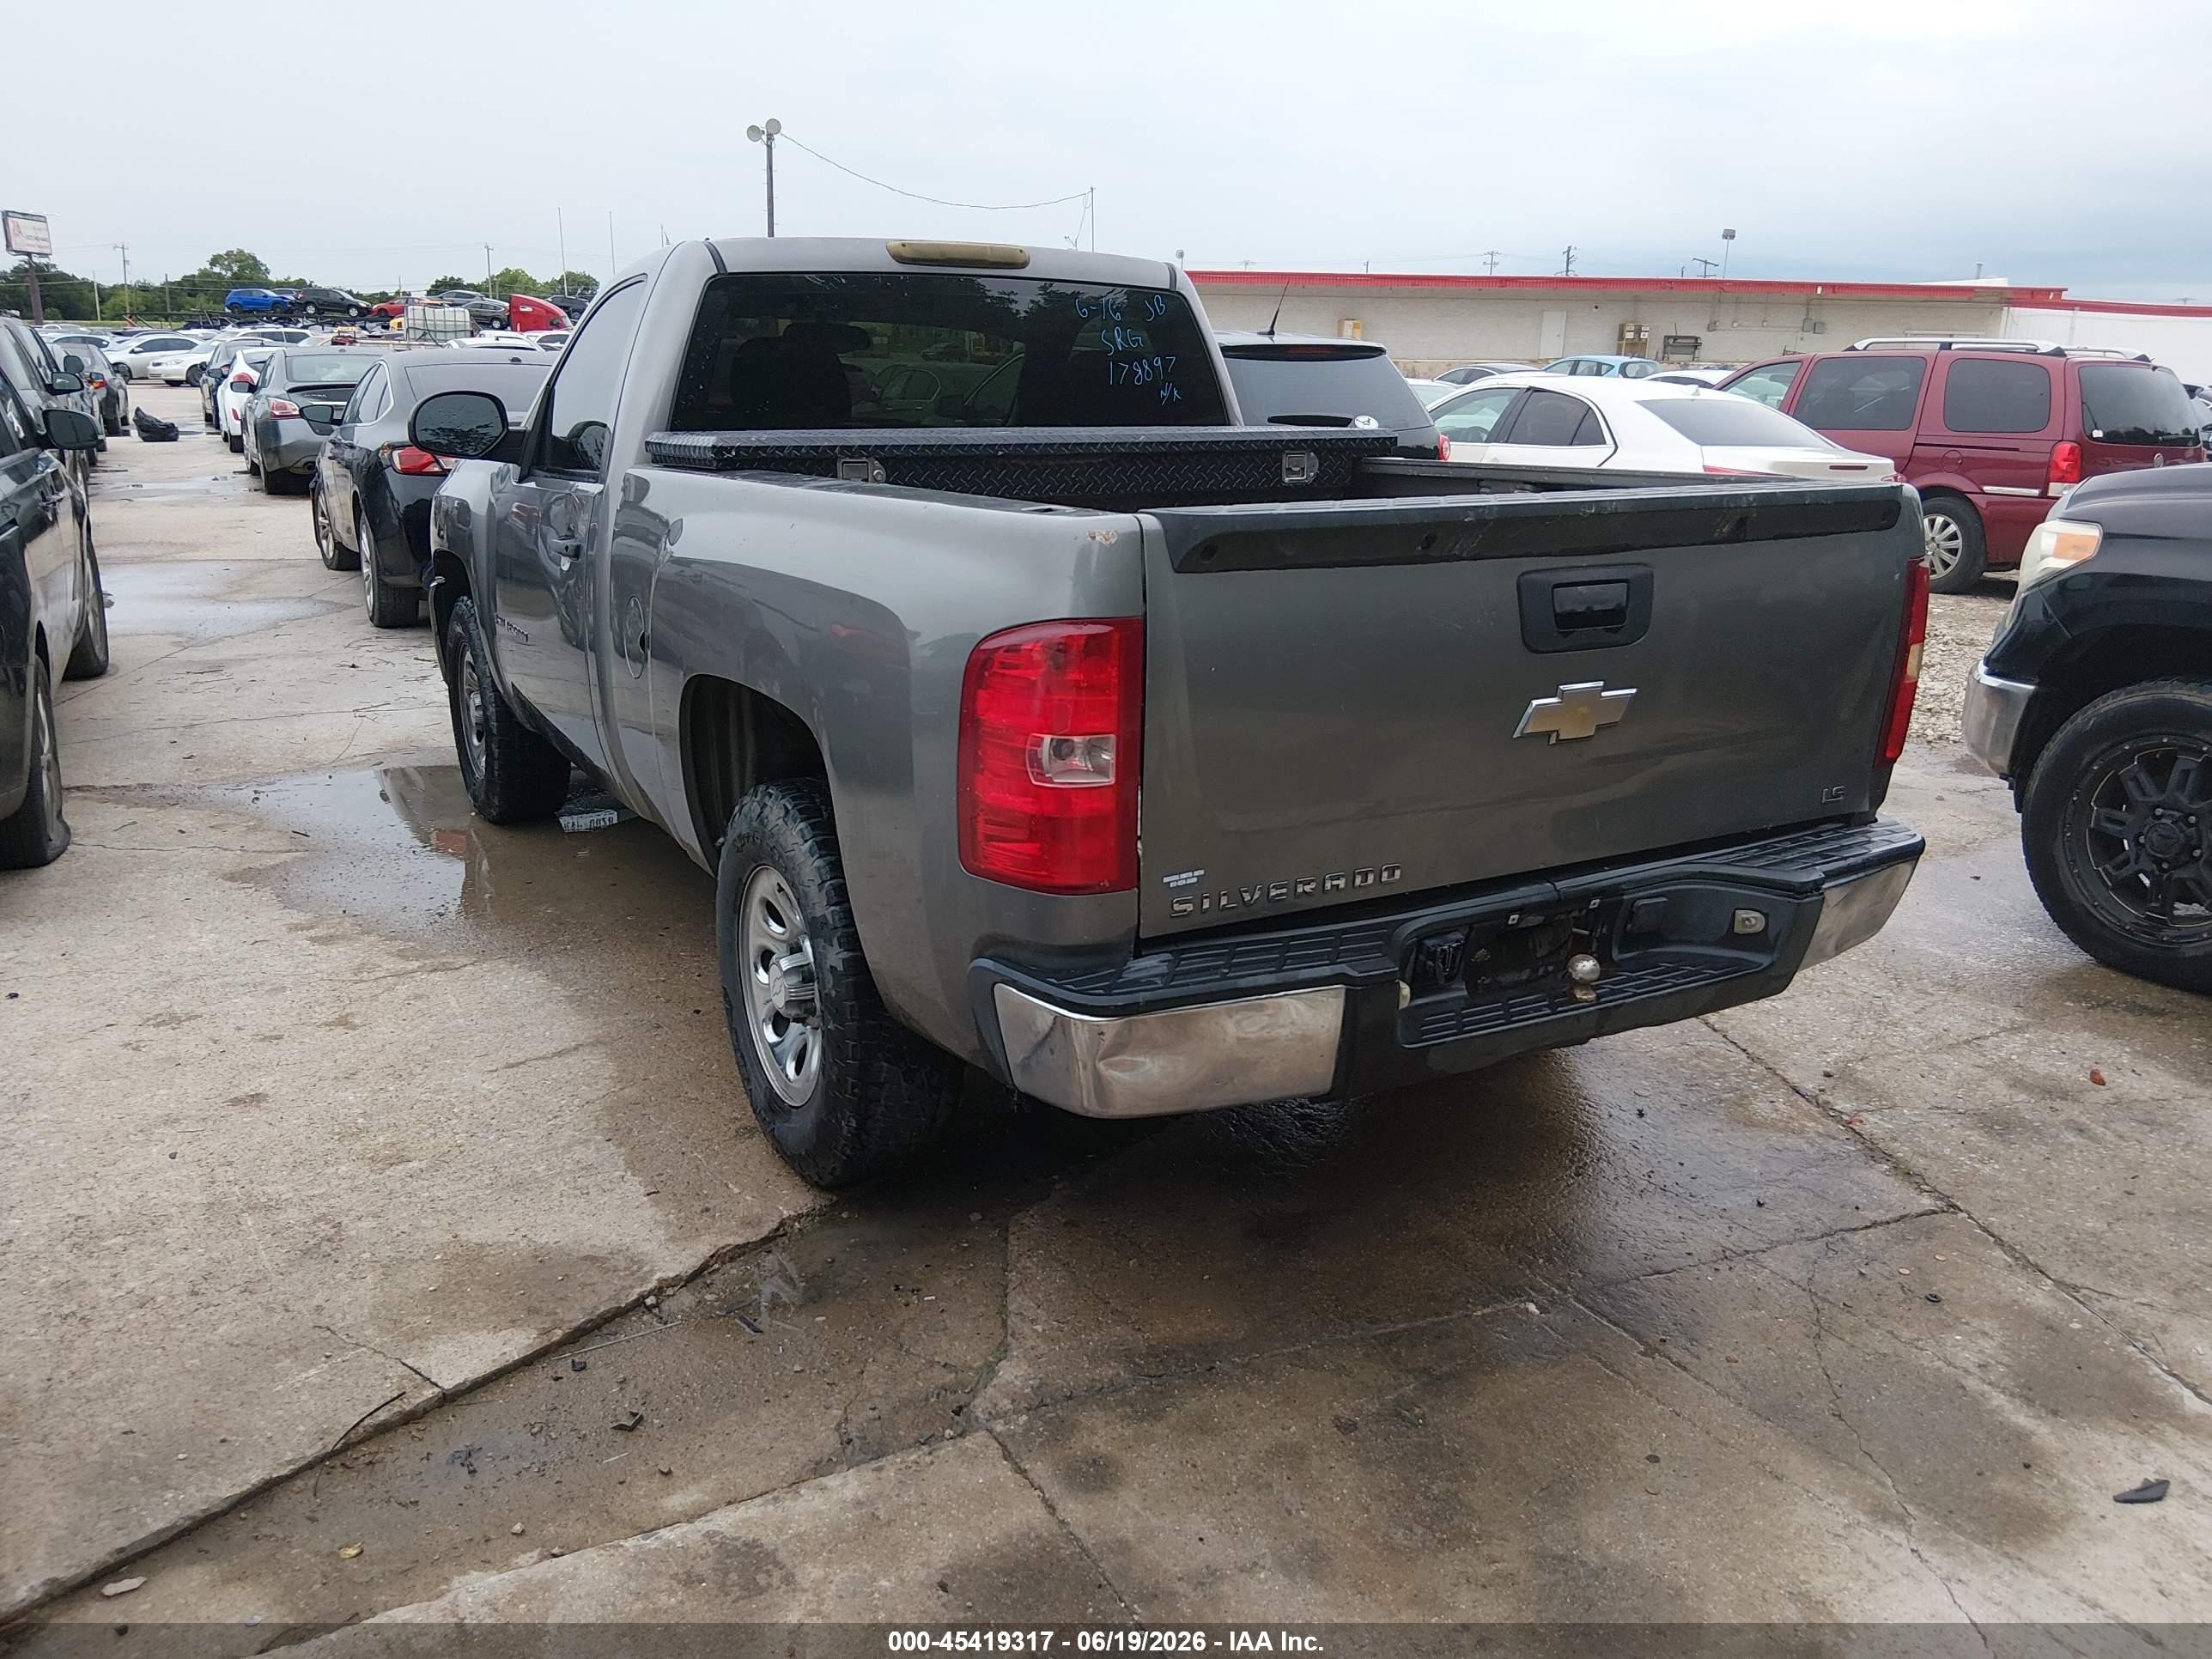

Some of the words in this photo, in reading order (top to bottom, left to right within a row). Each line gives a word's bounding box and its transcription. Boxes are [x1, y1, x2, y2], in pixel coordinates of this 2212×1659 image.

[1101, 325, 1144, 356] SRG
[1109, 356, 1176, 386] 178897
[1170, 862, 1401, 917] SILVERADO
